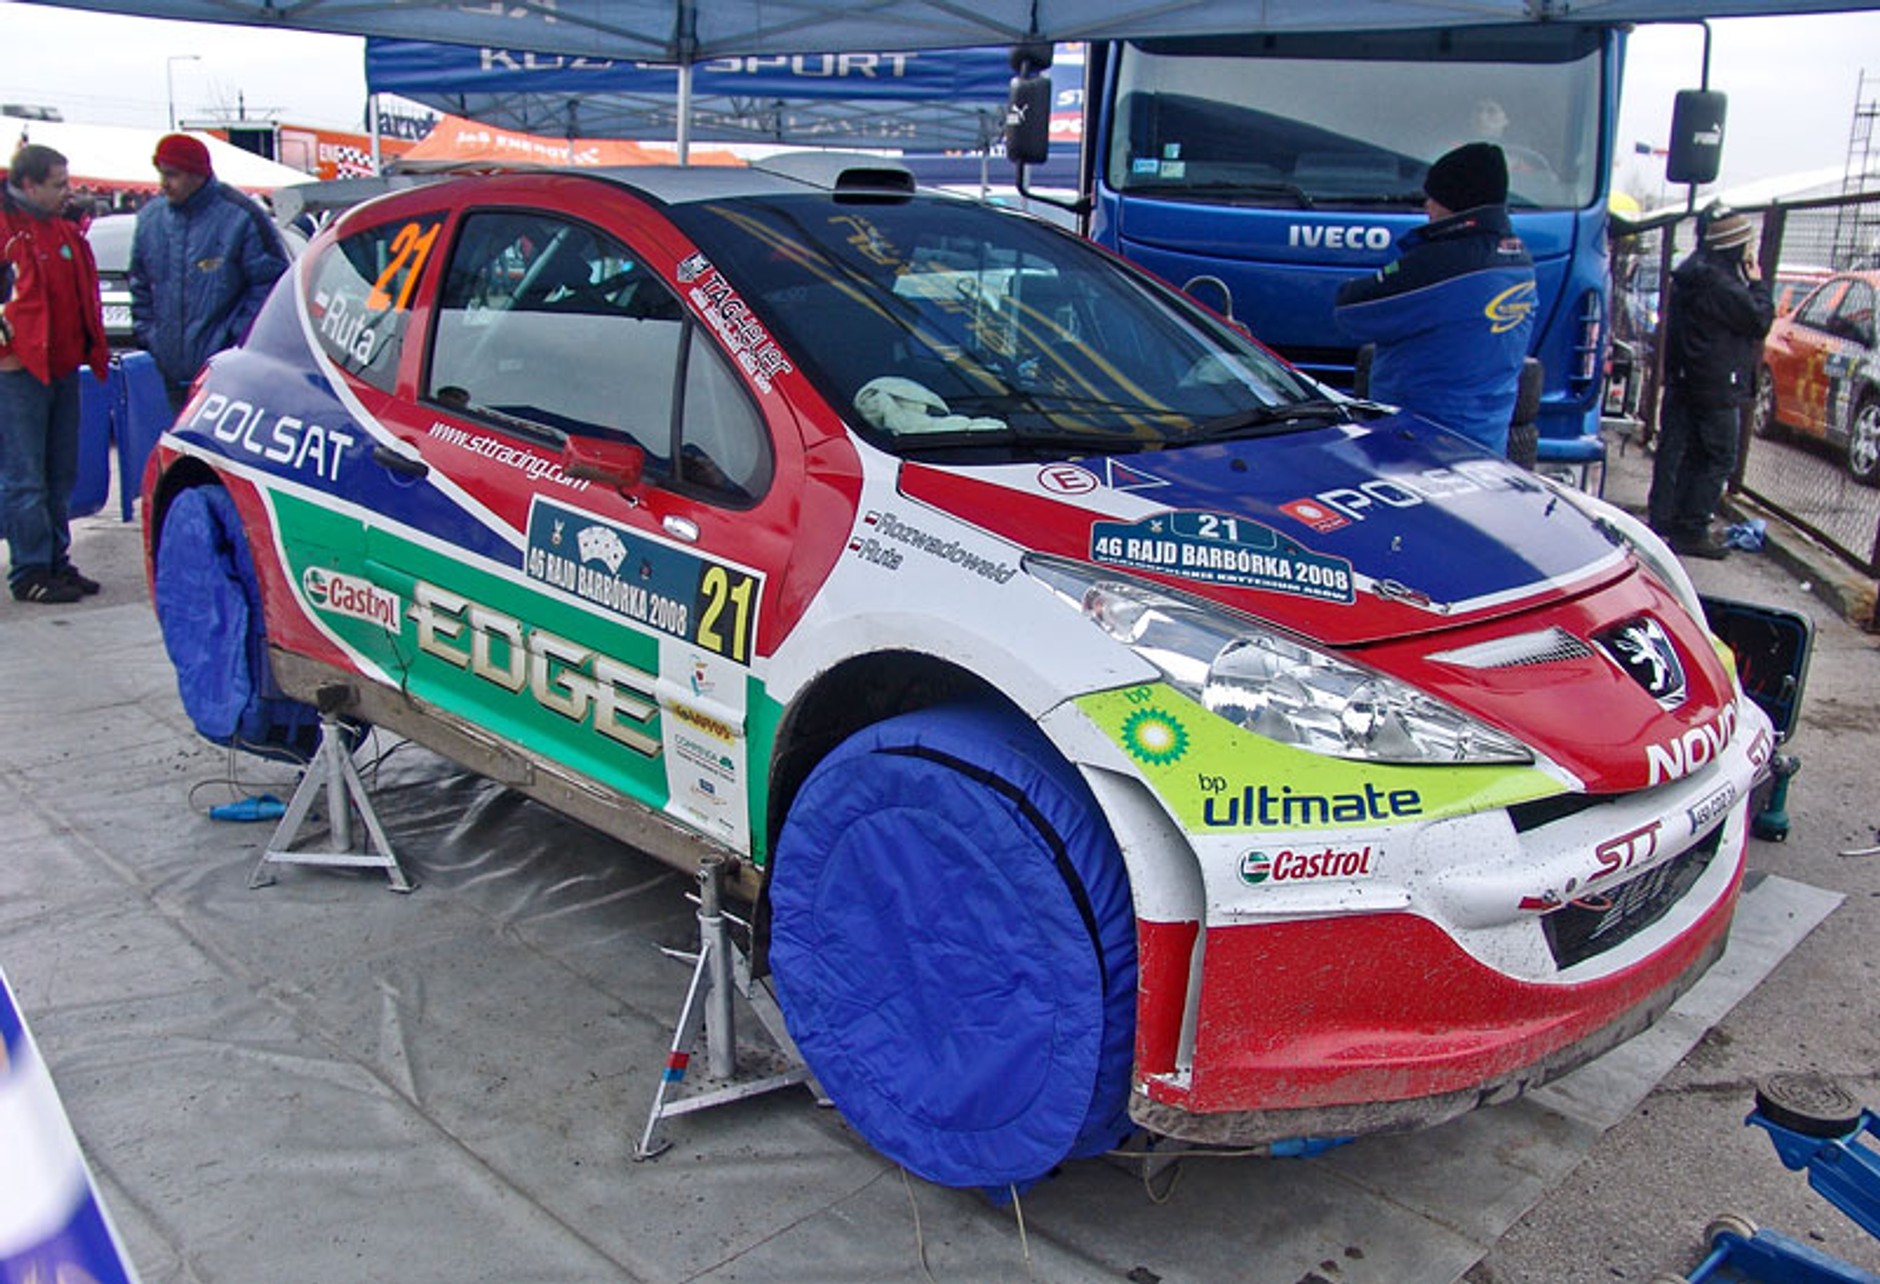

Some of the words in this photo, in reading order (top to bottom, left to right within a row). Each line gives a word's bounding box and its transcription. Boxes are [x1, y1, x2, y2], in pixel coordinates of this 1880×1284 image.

[1290, 225, 1391, 250] IVECO
[366, 222, 442, 314] 21
[321, 292, 376, 366] Ruta
[190, 393, 354, 481] POLSAT
[1197, 514, 1238, 542] 21
[1095, 537, 1122, 557] 46
[1127, 538, 1178, 564] RAJD
[1182, 543, 1292, 580] BARBÓRKA
[1295, 562, 1348, 591] 2008
[330, 577, 397, 628] Castrol
[528, 547, 547, 579] 46
[546, 551, 577, 592] RAJD
[577, 563, 648, 622] BARBÓRKA
[649, 592, 688, 636] 2008
[697, 566, 754, 662] 21
[405, 579, 662, 759] EDGE
[1124, 684, 1152, 705] bp
[1199, 773, 1228, 796] bp
[1203, 783, 1423, 827] ultimate
[1271, 846, 1372, 882] Castrol
[1587, 819, 1662, 883] STT
